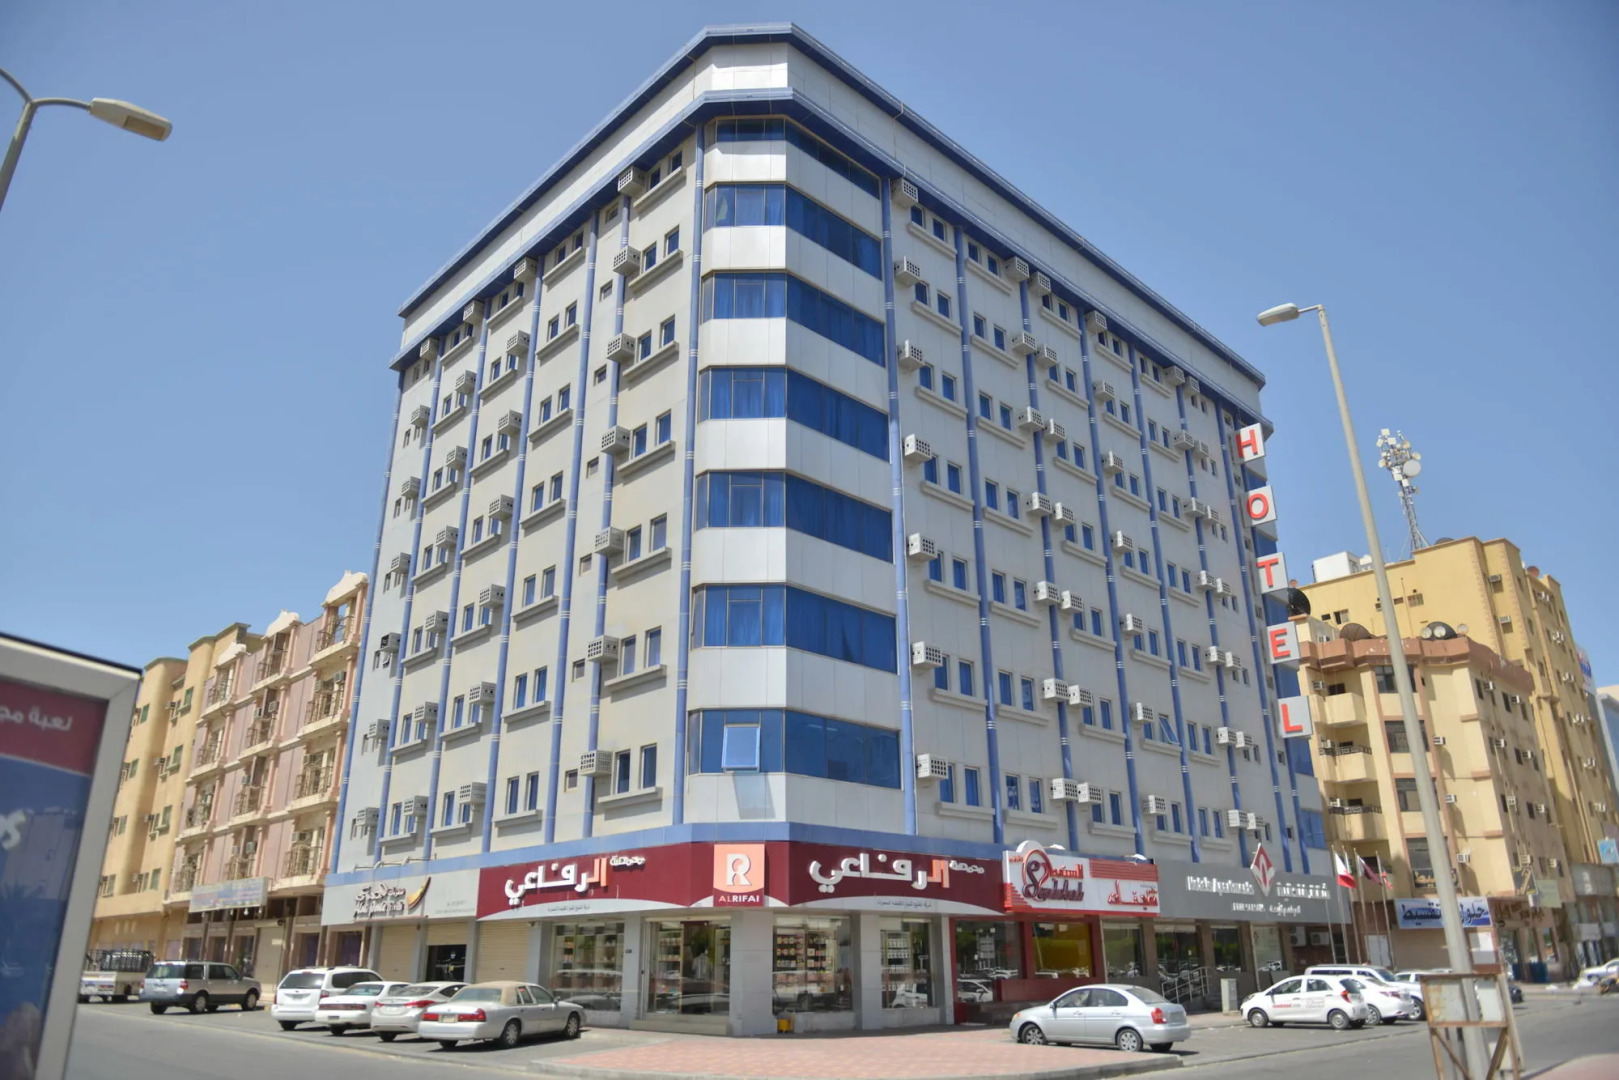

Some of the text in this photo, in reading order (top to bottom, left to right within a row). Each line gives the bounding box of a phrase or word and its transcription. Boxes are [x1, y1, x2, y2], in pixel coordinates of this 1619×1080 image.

[1235, 429, 1303, 733] HOTEL
[28, 705, 73, 731] لعبة
[504, 857, 607, 906] الرفاعي
[809, 853, 950, 893] الرفاعي
[718, 895, 760, 903] ALRIFAI
